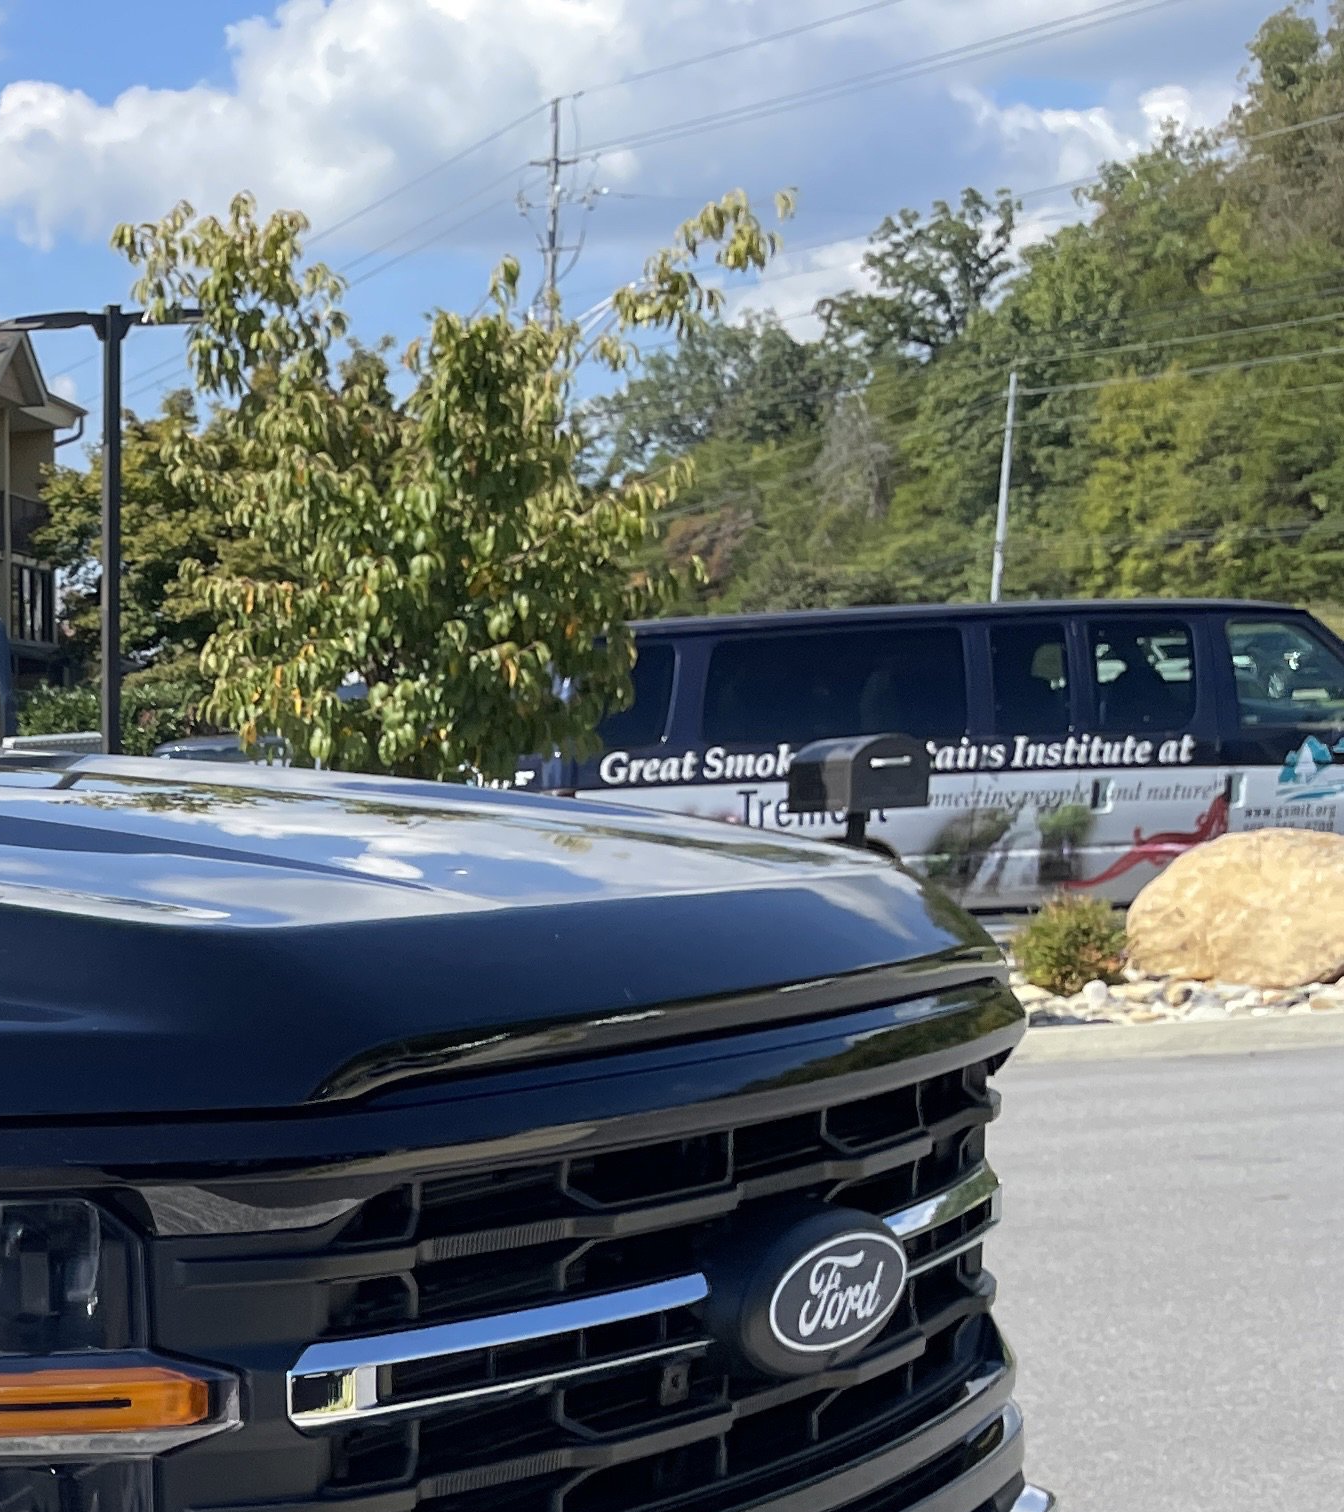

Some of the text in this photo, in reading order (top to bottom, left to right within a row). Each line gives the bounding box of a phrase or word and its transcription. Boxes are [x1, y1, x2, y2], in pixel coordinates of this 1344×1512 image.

[599, 749, 699, 785] Great
[703, 743, 797, 780] Smok
[1011, 734, 1154, 768] Institute
[1158, 733, 1196, 764] at
[1111, 780, 1142, 800] nd
[798, 1249, 884, 1337] Ford
